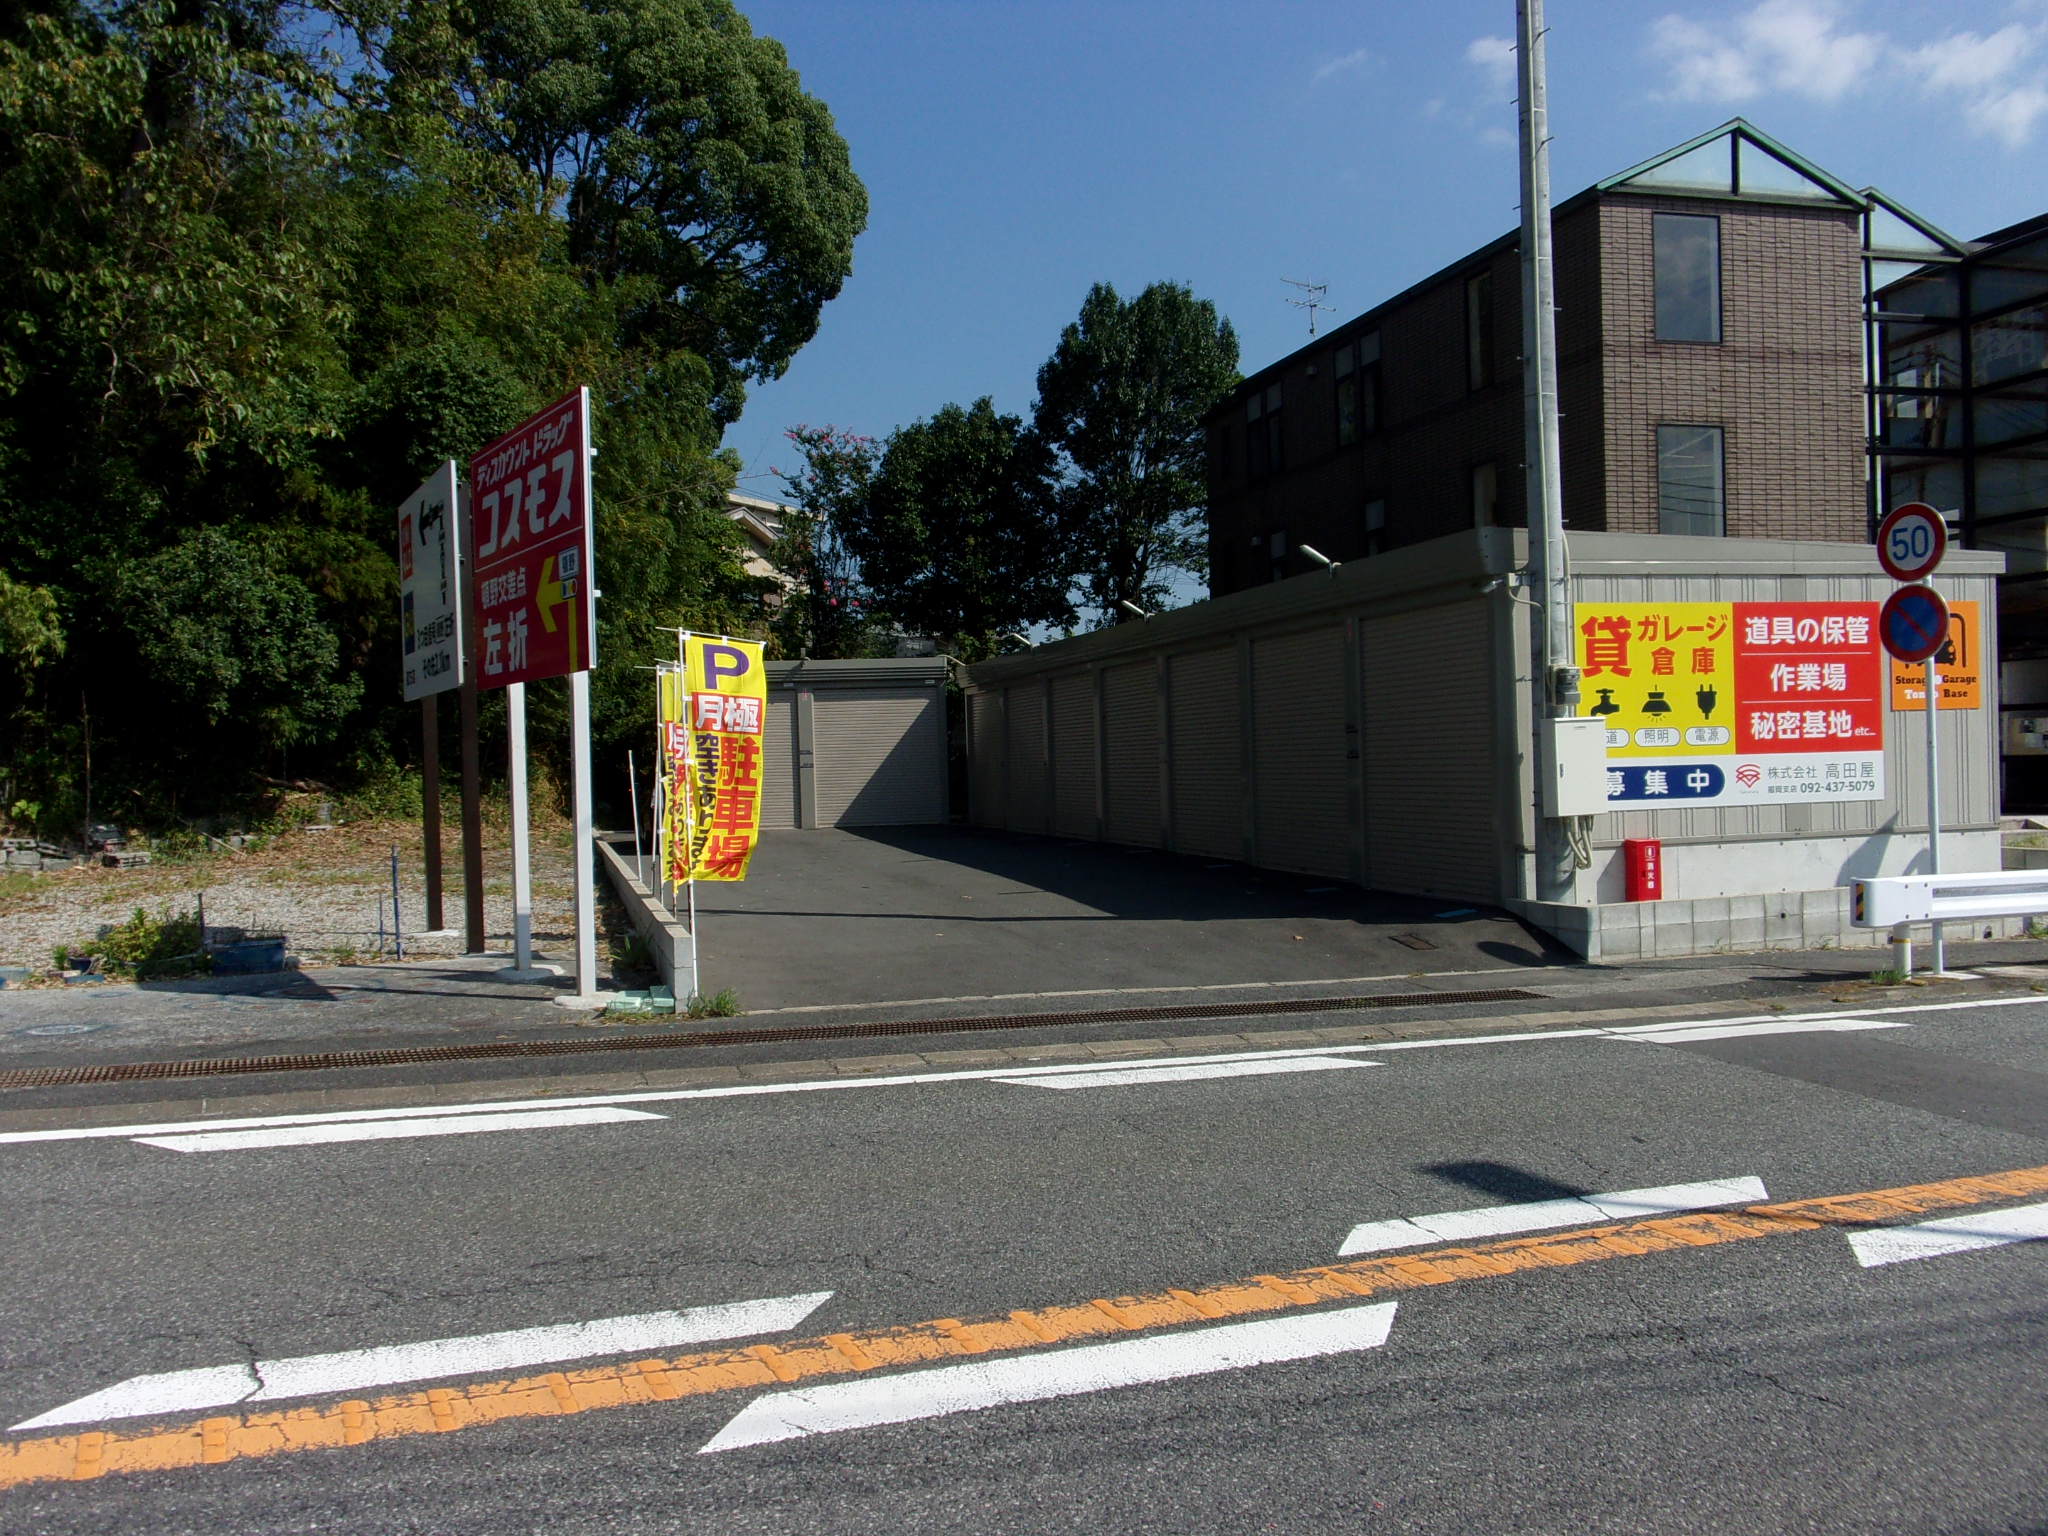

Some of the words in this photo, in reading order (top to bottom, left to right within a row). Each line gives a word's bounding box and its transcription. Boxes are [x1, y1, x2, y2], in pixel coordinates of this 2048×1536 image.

[477, 438, 530, 492] ディスカウント
[533, 410, 573, 460] ドラッグ
[479, 449, 575, 559] コスモス
[1892, 524, 1930, 561] 50
[483, 608, 528, 676] 左折
[1637, 614, 1727, 643] ガレージ
[1745, 616, 1870, 646] 道具の保管
[1581, 615, 1633, 678] 貸
[1651, 646, 1716, 676] 倉庫
[703, 643, 750, 690] P
[1770, 663, 1847, 692] 作業場
[1942, 674, 1977, 686] Garage
[1943, 688, 1969, 698] Base
[695, 695, 759, 733] 月極
[1751, 710, 1852, 740] 秘密基地
[1644, 729, 1669, 744] 照明
[1694, 728, 1720, 743] 電源
[1767, 766, 1817, 779] 株式会社
[1825, 761, 1874, 779] 高田屋
[1800, 780, 1875, 794] 092-437-5079
[704, 736, 761, 878] 駐車場
